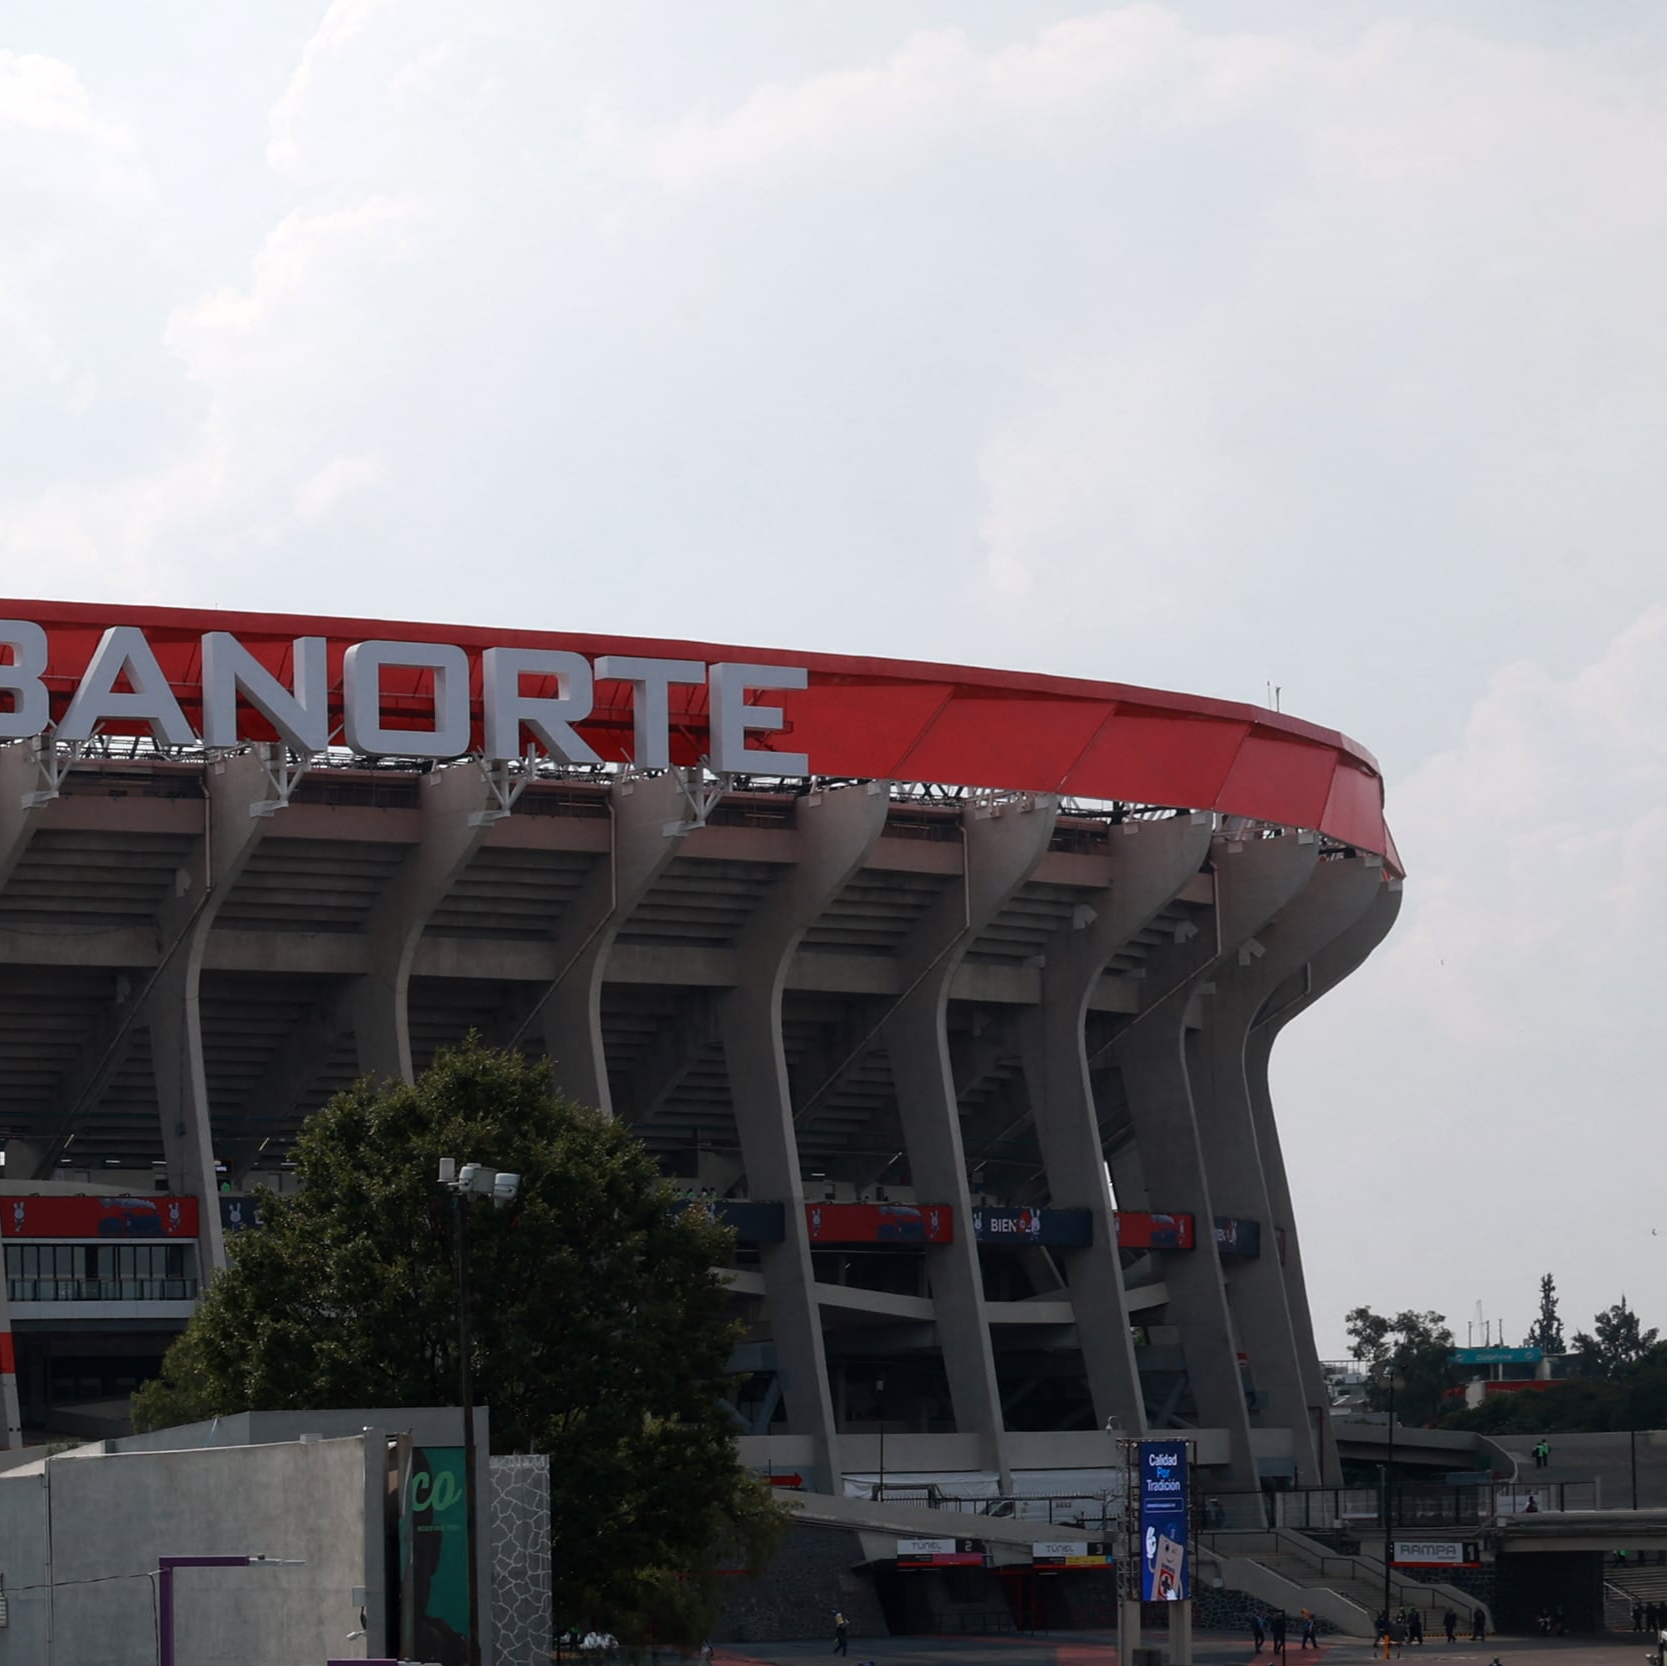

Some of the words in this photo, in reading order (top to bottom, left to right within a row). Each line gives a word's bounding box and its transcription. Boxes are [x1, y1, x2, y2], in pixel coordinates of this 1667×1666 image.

[1148, 1453, 1178, 1467] Calidad
[964, 1540, 973, 1552] 2
[1400, 1545, 1457, 1556] RAMPA
